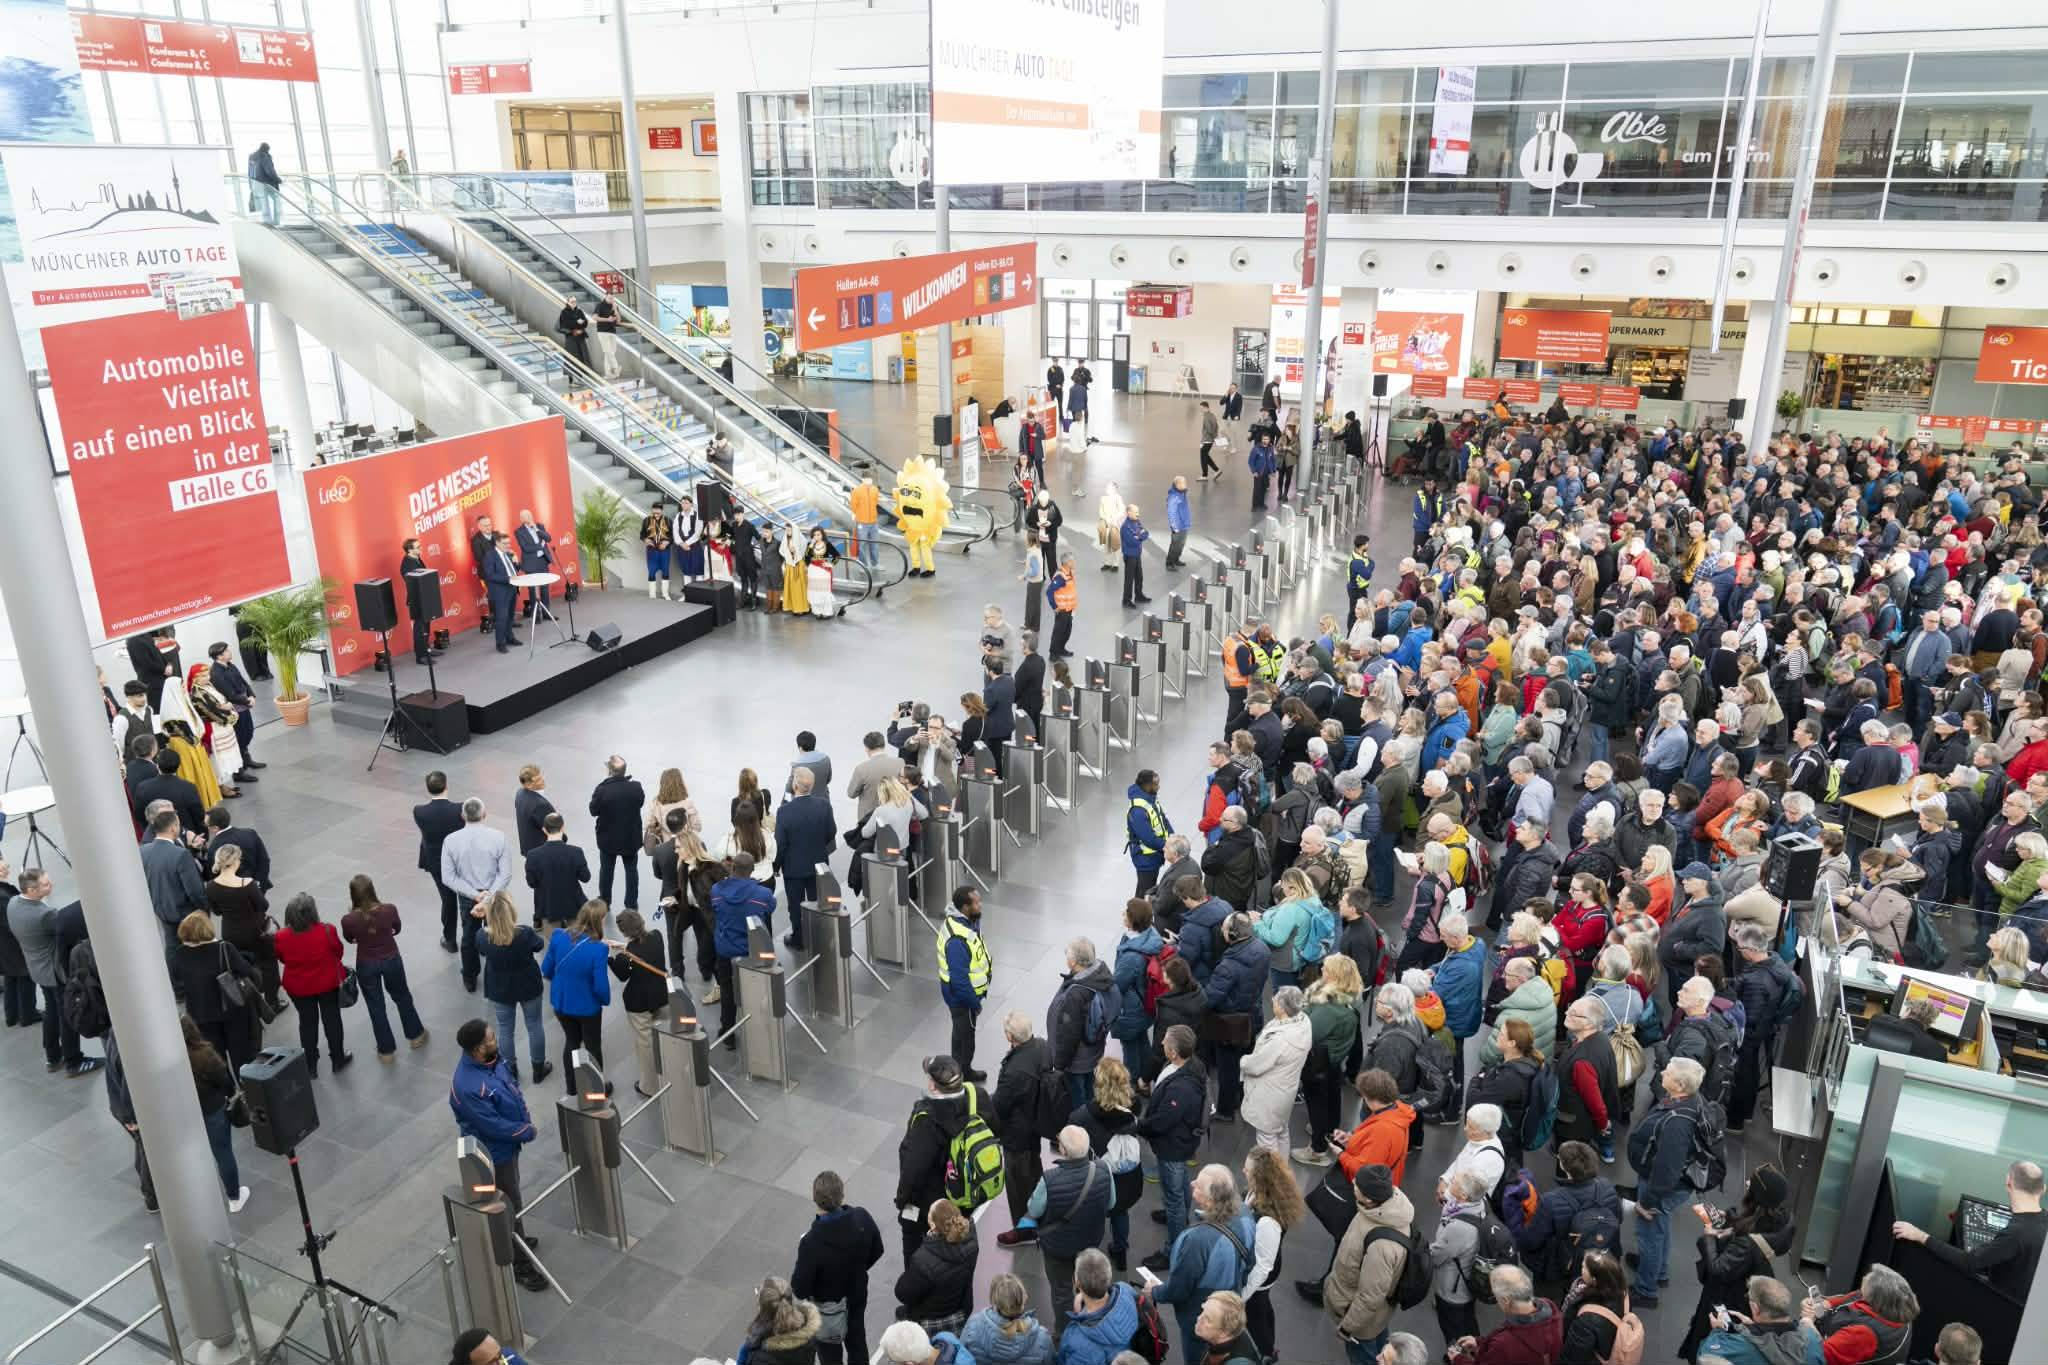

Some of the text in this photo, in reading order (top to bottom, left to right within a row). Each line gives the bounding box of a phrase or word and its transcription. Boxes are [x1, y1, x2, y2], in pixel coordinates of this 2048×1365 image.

[1014, 54, 1045, 79] AUTO
[1682, 150, 1712, 164] am
[31, 246, 227, 272] MÜNCHNER AUTO TAGE
[39, 294, 55, 303] Der
[59, 288, 128, 300] Automobilsalon
[902, 261, 968, 320] WILLKOMMEN
[103, 344, 244, 384] Automobile
[162, 376, 251, 409] Vielfalt
[73, 408, 256, 461] auf einen Blick
[193, 441, 260, 472] in der
[180, 469, 268, 506] Halle C6
[408, 456, 491, 518] DIE MESSE
[414, 483, 494, 535] FÜR MEINE FREIZEIT
